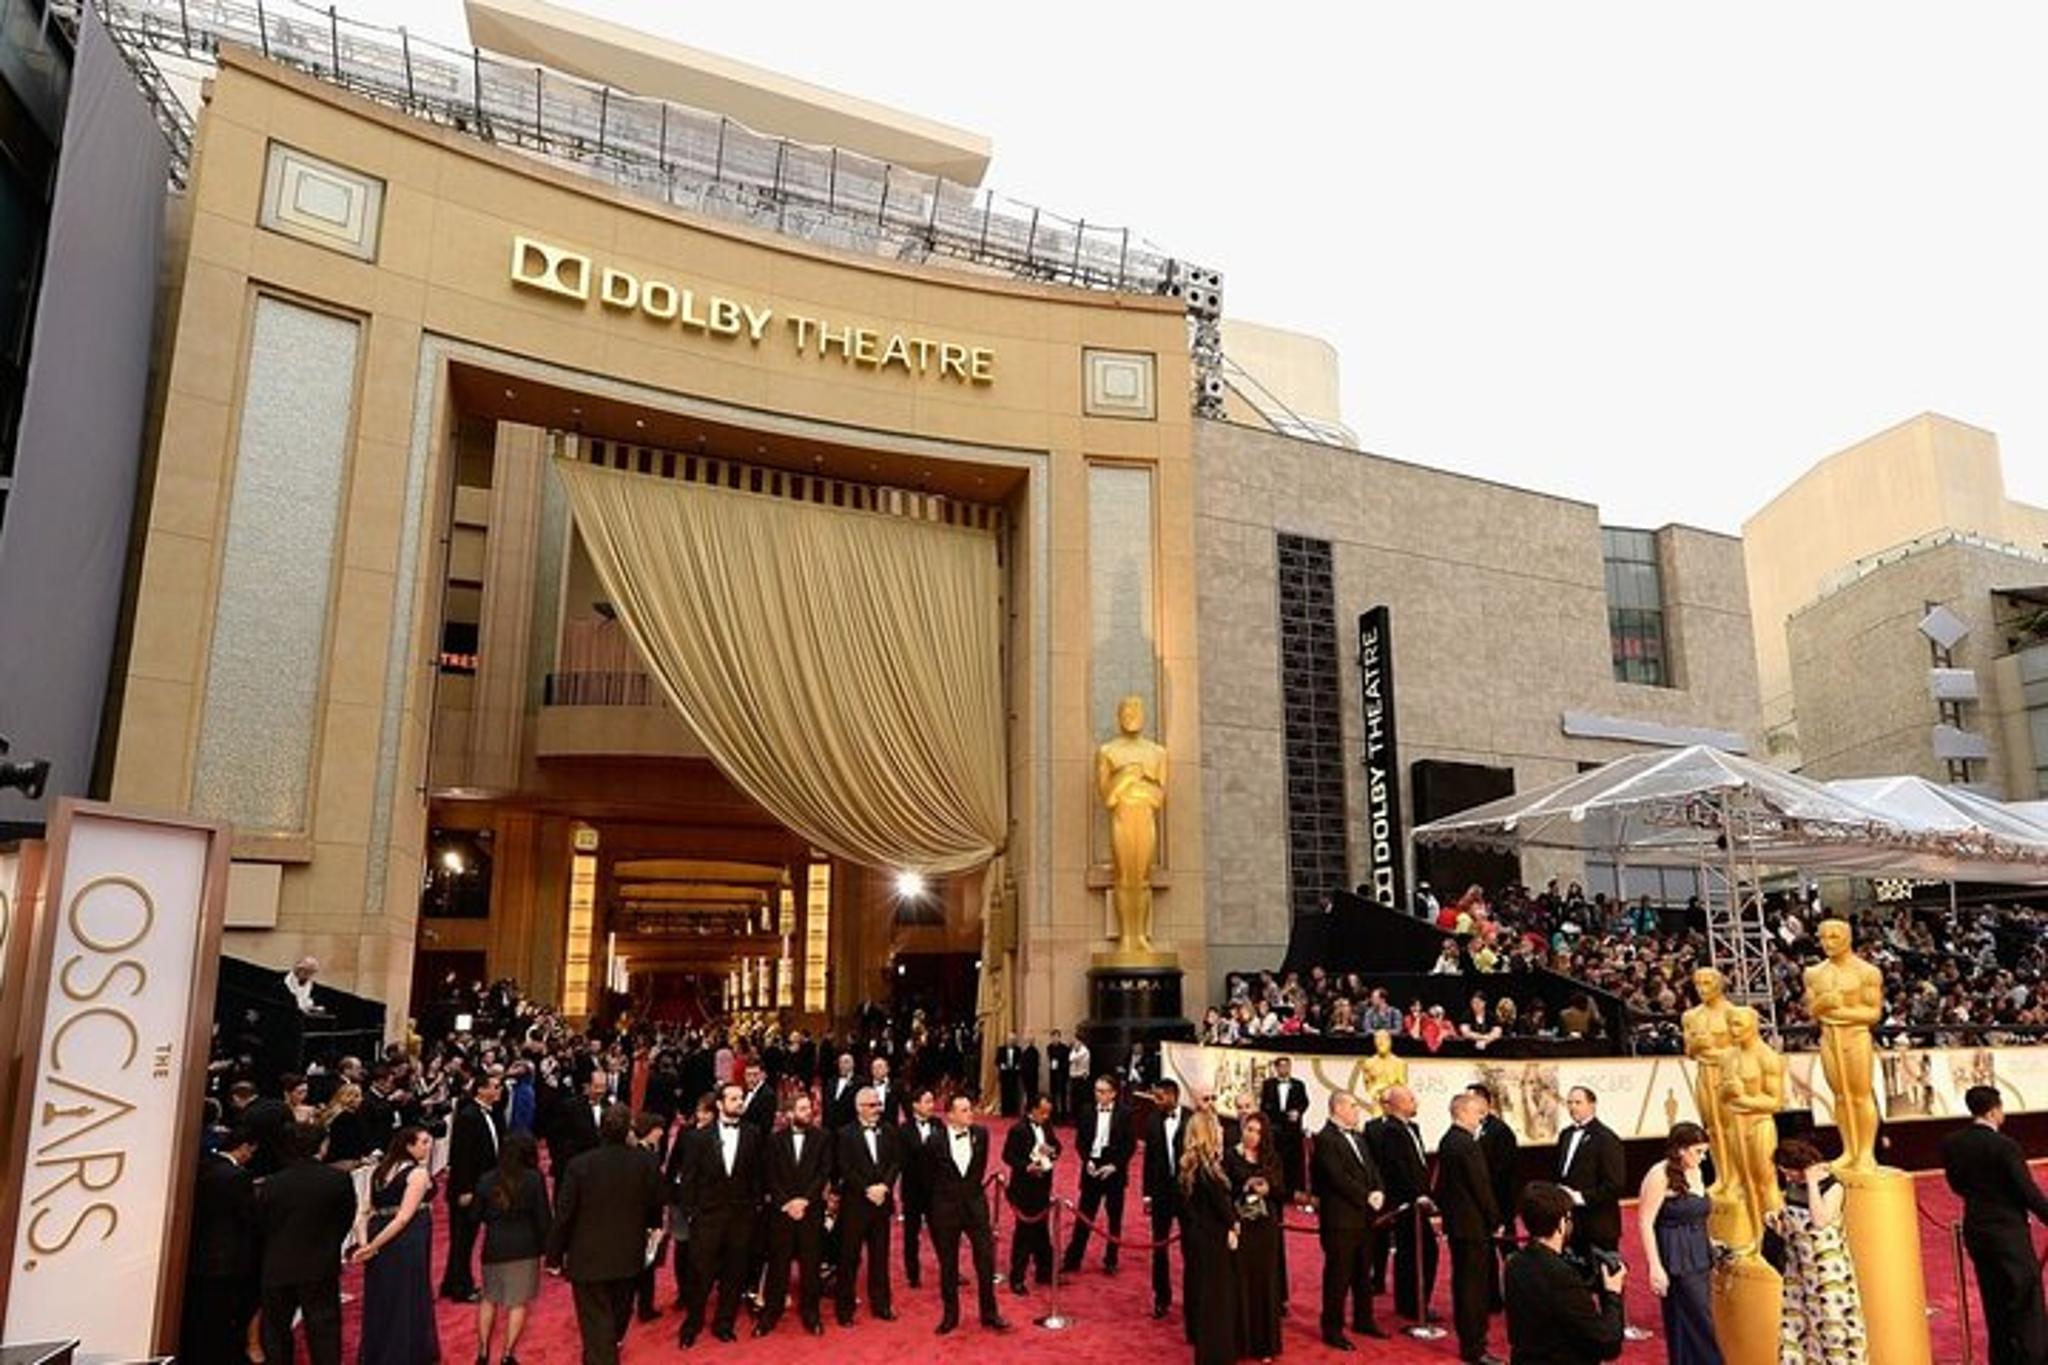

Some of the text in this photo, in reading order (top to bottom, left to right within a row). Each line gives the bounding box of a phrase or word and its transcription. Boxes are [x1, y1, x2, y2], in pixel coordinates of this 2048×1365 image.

[602, 267, 773, 341] DOLBY
[787, 314, 995, 380] THEATRE
[1362, 625, 1384, 760] THEATRE
[1370, 766, 1393, 862] DOLBY
[153, 1042, 173, 1079] THE
